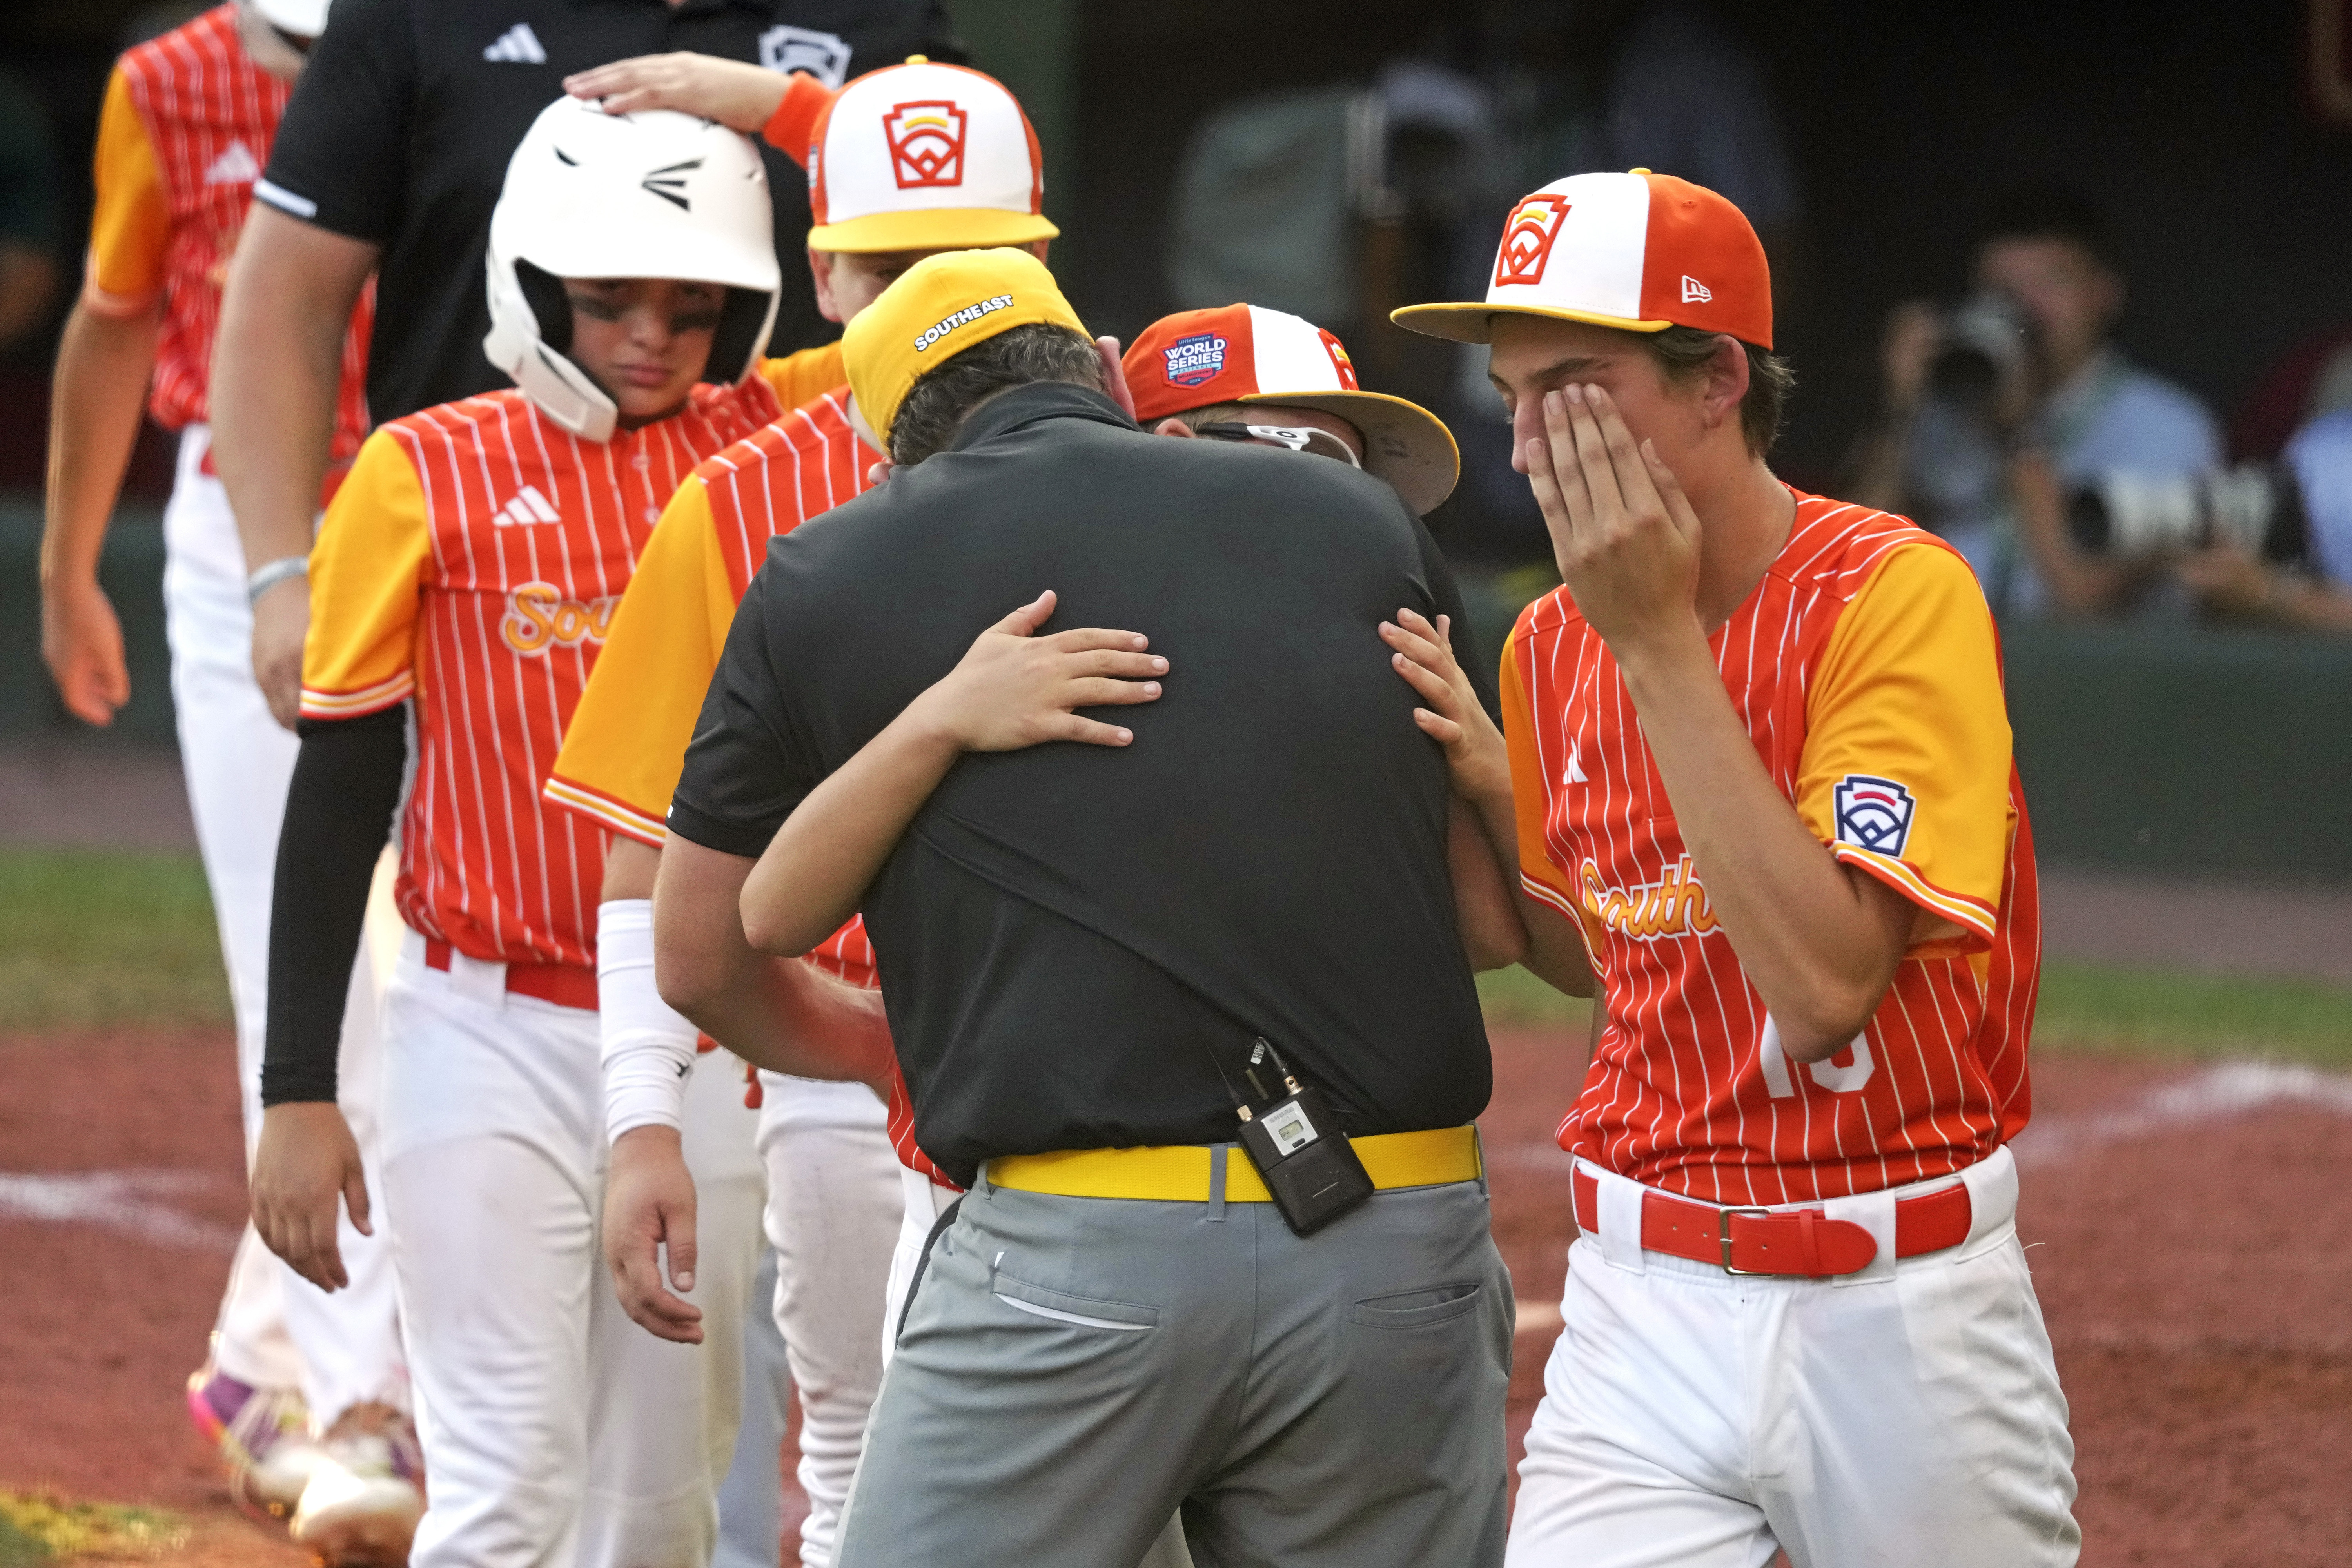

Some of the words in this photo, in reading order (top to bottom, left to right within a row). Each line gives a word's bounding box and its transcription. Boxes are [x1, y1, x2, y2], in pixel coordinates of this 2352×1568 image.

[914, 294, 1014, 352] SOUTHEAST
[1165, 339, 1225, 360] WORLD
[1168, 351, 1223, 370] SERIES
